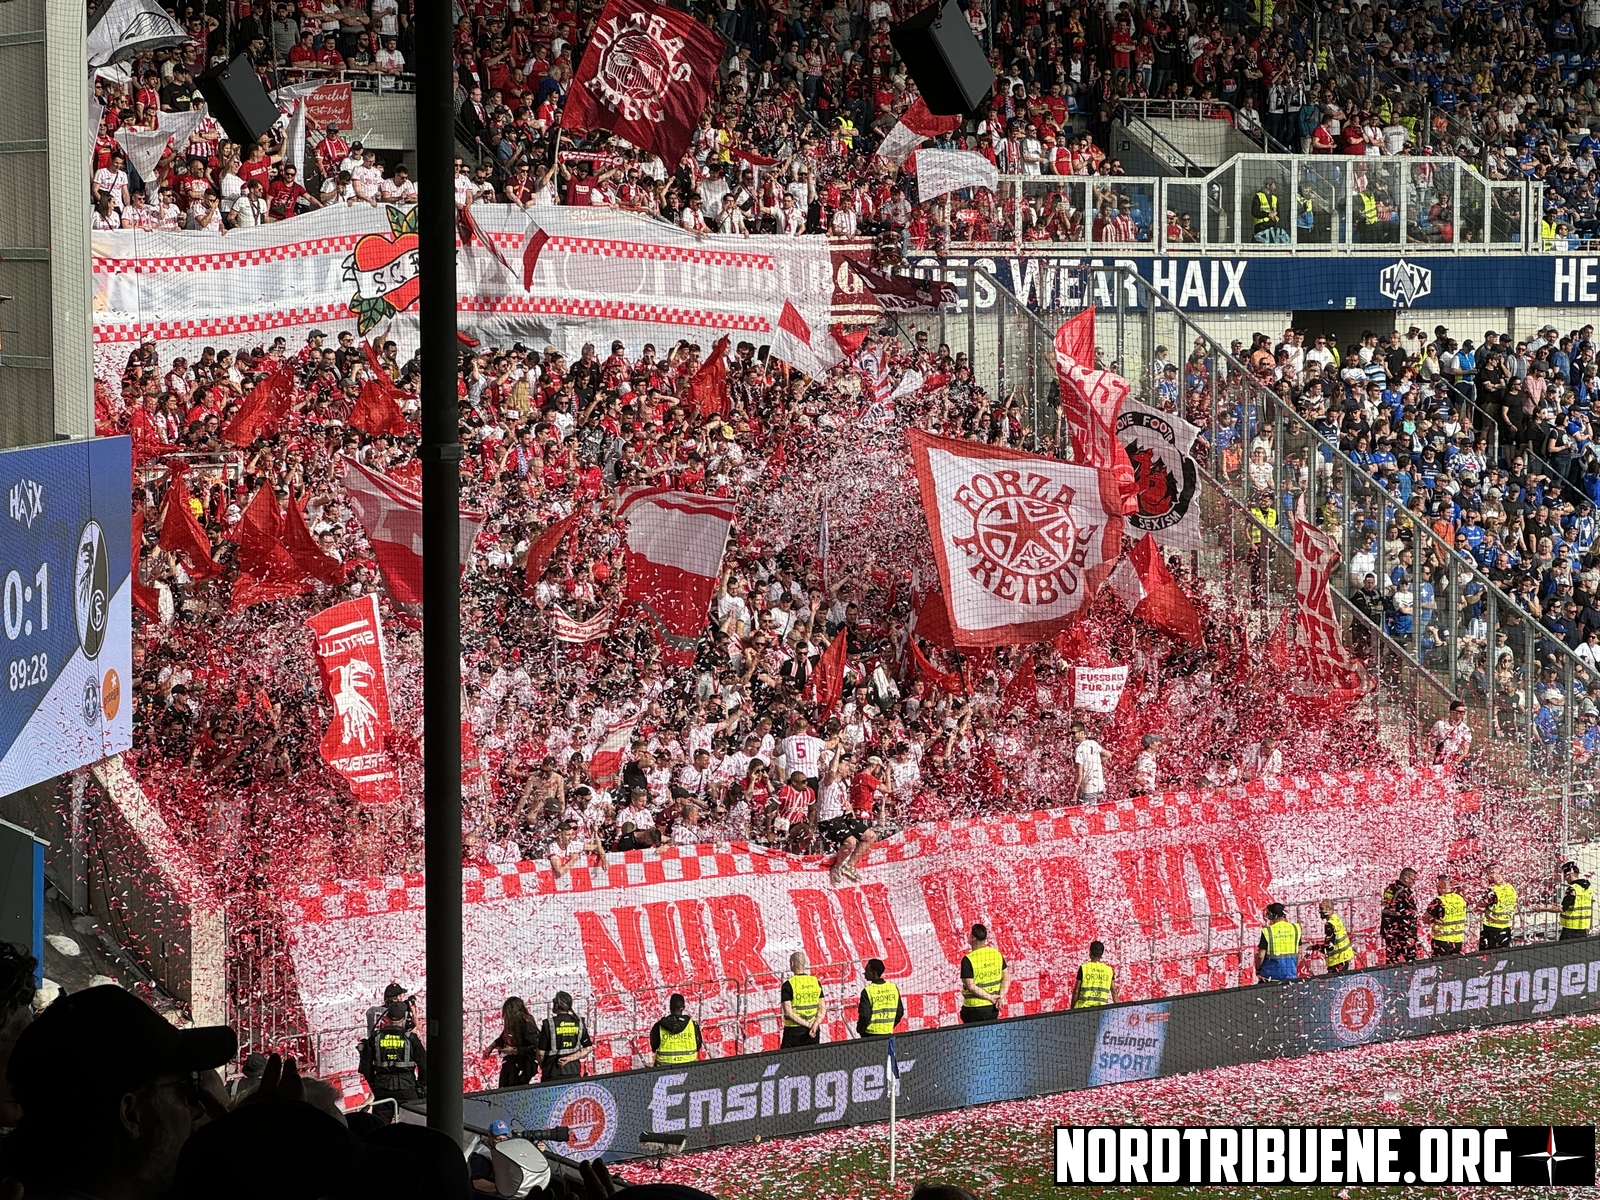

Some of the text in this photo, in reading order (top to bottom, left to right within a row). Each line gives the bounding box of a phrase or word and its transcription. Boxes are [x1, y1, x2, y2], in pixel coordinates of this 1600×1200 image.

[592, 12, 692, 83] ULTRAS
[1009, 257, 1140, 309] WEAR
[1150, 258, 1248, 309] HAIX
[1381, 259, 1431, 307] HAIX
[1116, 414, 1134, 432] OVE
[953, 470, 1078, 514] FORZA
[1138, 511, 1181, 530] SEXISM
[952, 524, 1100, 606] FREIBURG
[3, 562, 48, 641] 0:1
[9, 652, 48, 693] 89:28
[796, 742, 807, 759] 5
[574, 893, 783, 1000] NUR
[787, 881, 912, 985] DU
[1112, 838, 1276, 938] WIR
[662, 1032, 693, 1040] ORDNER
[1102, 1030, 1159, 1051] Ensinger
[1098, 1052, 1155, 1072] SPORT
[648, 1059, 917, 1133] Ensinger
